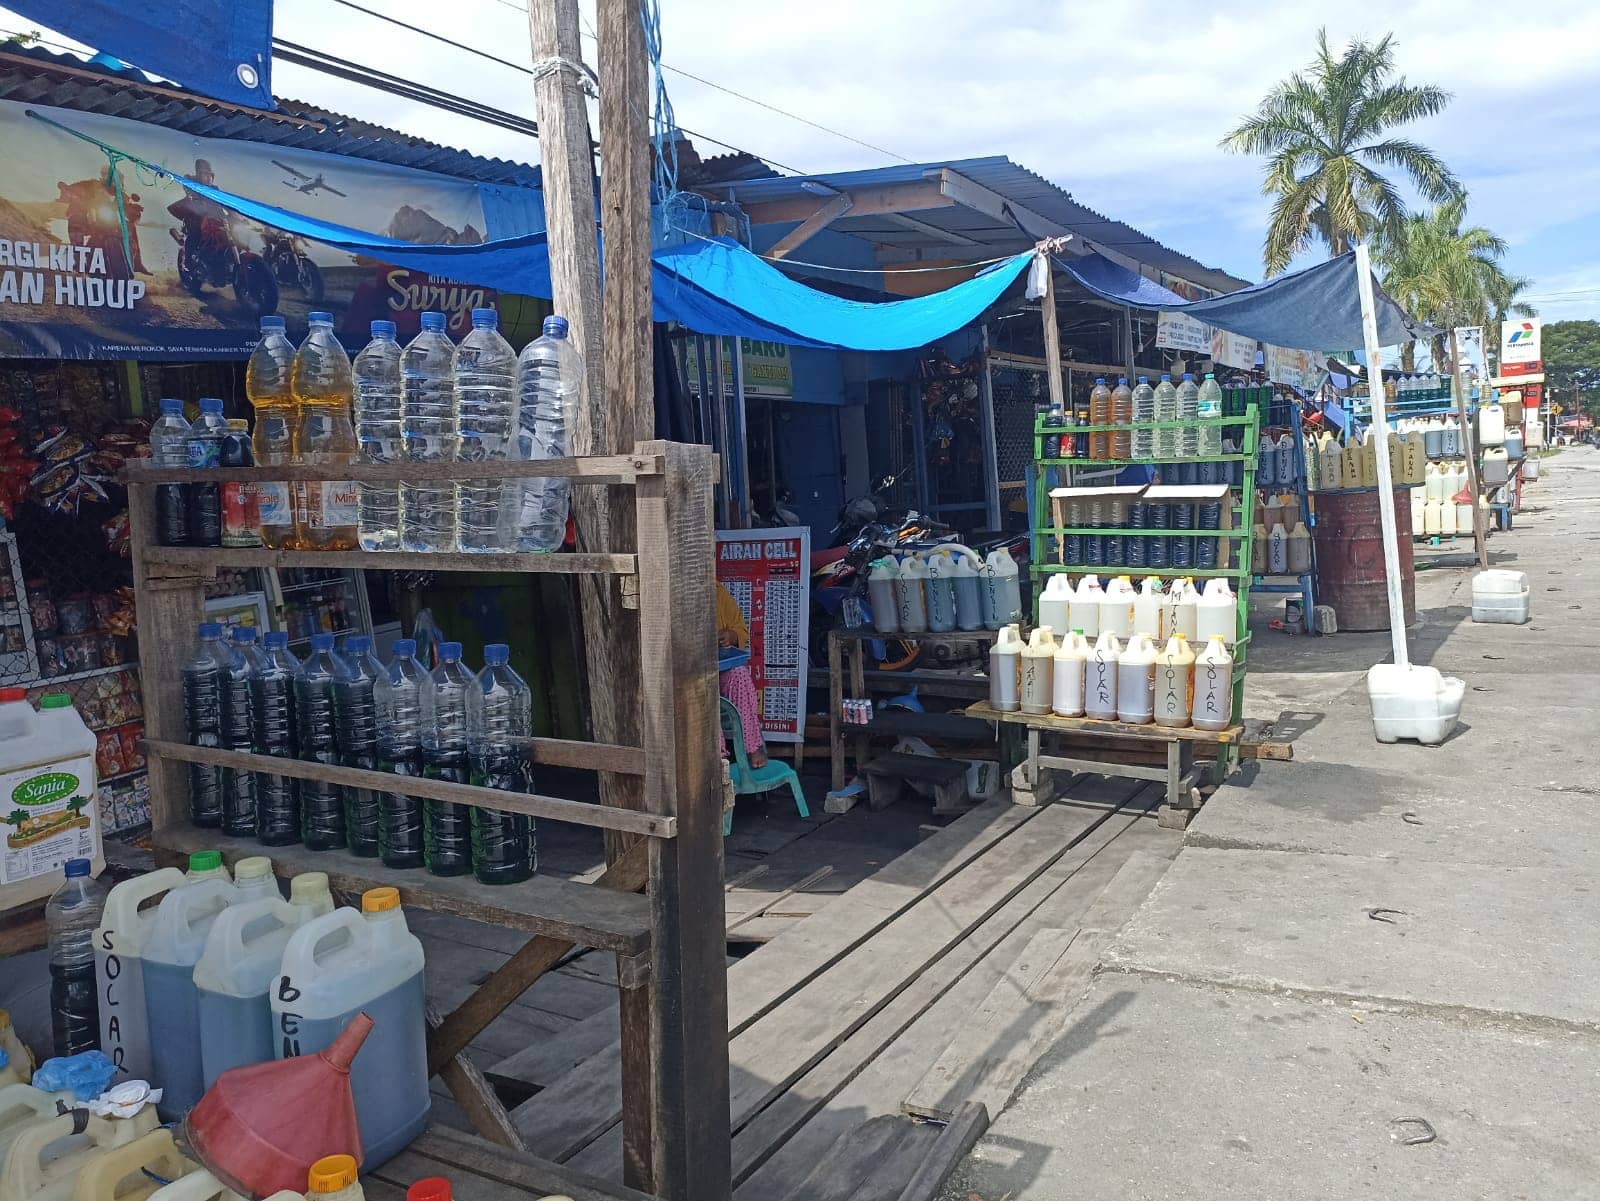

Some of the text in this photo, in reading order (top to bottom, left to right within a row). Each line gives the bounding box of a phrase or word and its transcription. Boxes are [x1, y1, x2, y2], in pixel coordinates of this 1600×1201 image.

[49, 243, 107, 274] KITA
[55, 274, 146, 309] HIDUP
[764, 541, 797, 559] CELL
[1165, 654, 1178, 714] SOLAR
[1206, 656, 1218, 714] SOLAR
[24, 778, 67, 799] Sania
